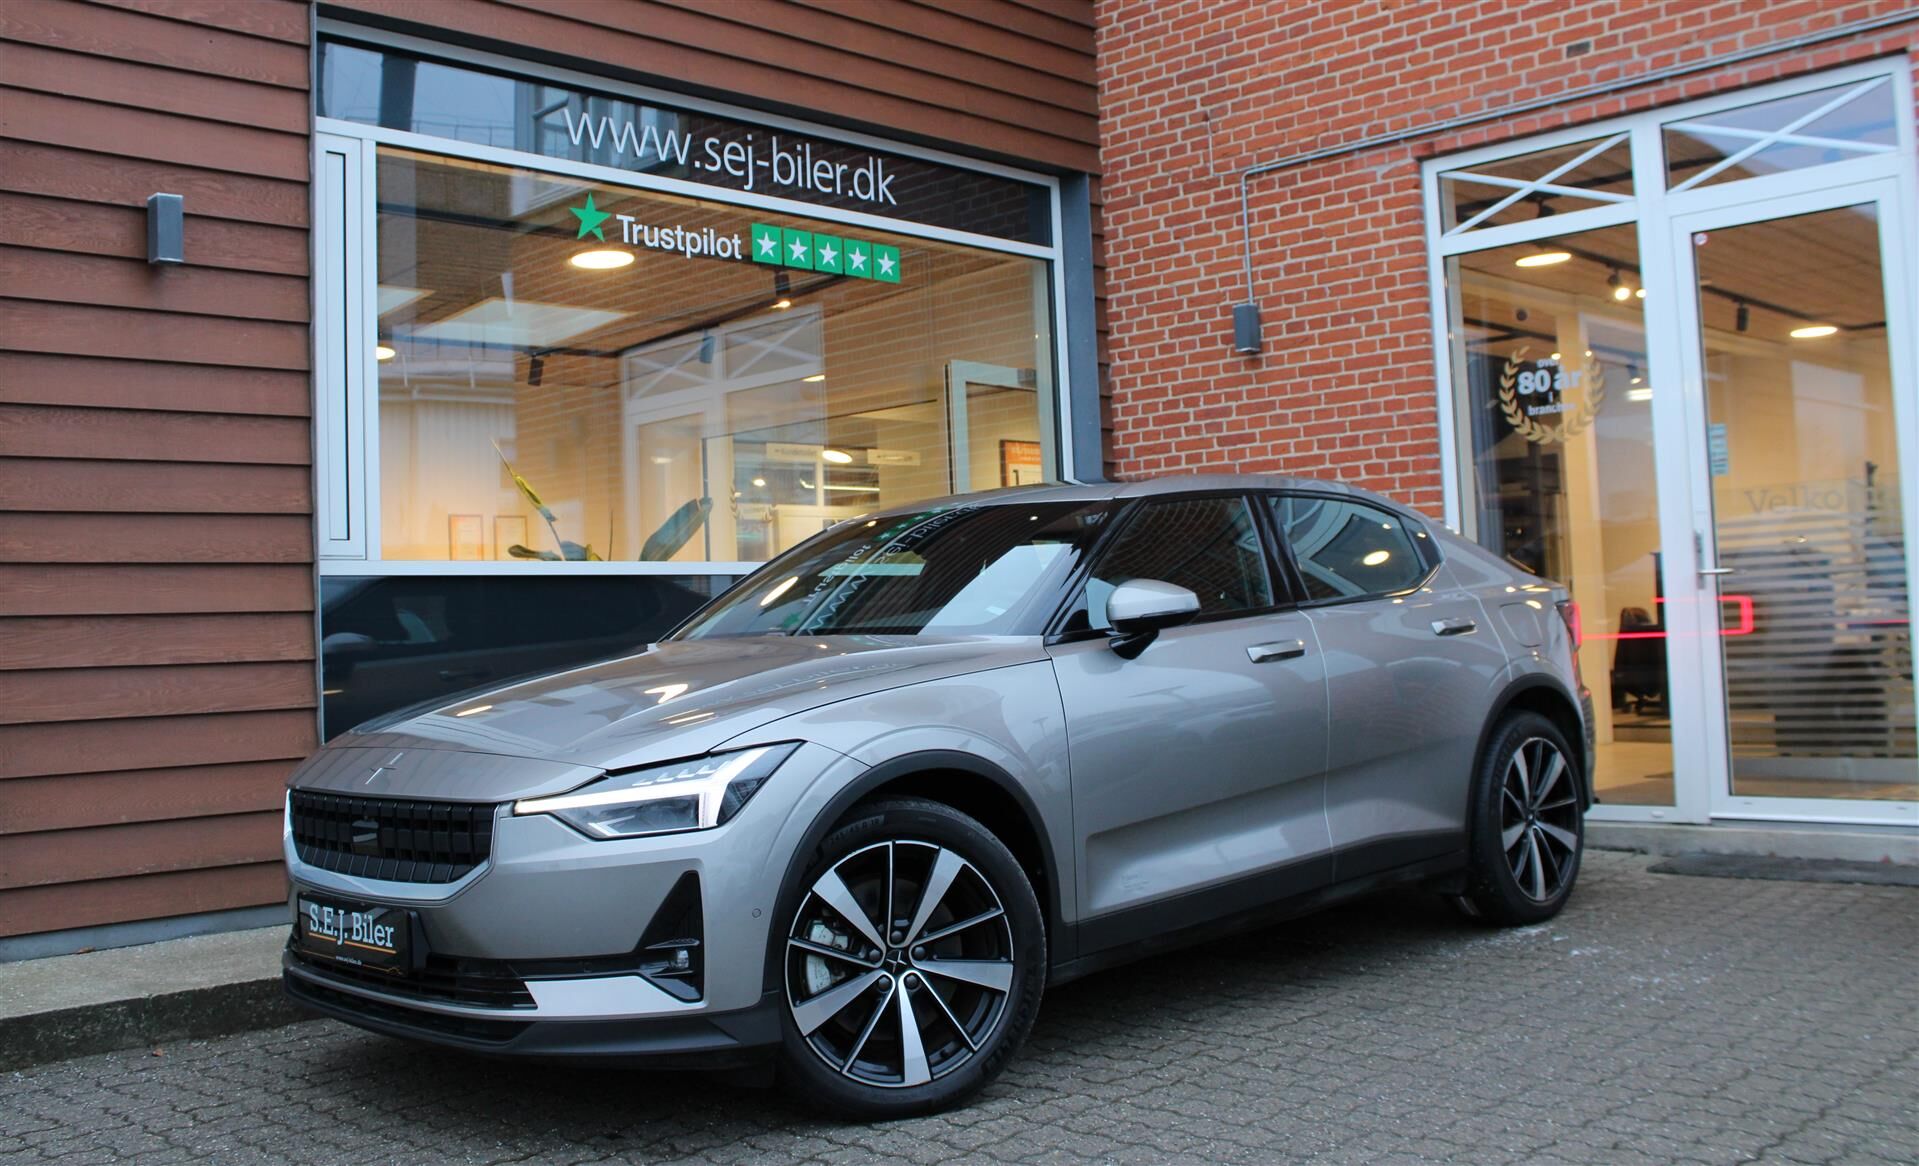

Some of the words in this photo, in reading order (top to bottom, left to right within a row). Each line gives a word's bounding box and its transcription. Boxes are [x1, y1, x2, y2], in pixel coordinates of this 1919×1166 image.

[565, 109, 896, 205] www.sej-biler.dk
[616, 213, 742, 259] Trustpilot
[1518, 370, 1550, 394] 80
[310, 904, 348, 945] S.E.J.
[352, 912, 394, 947] Biler
